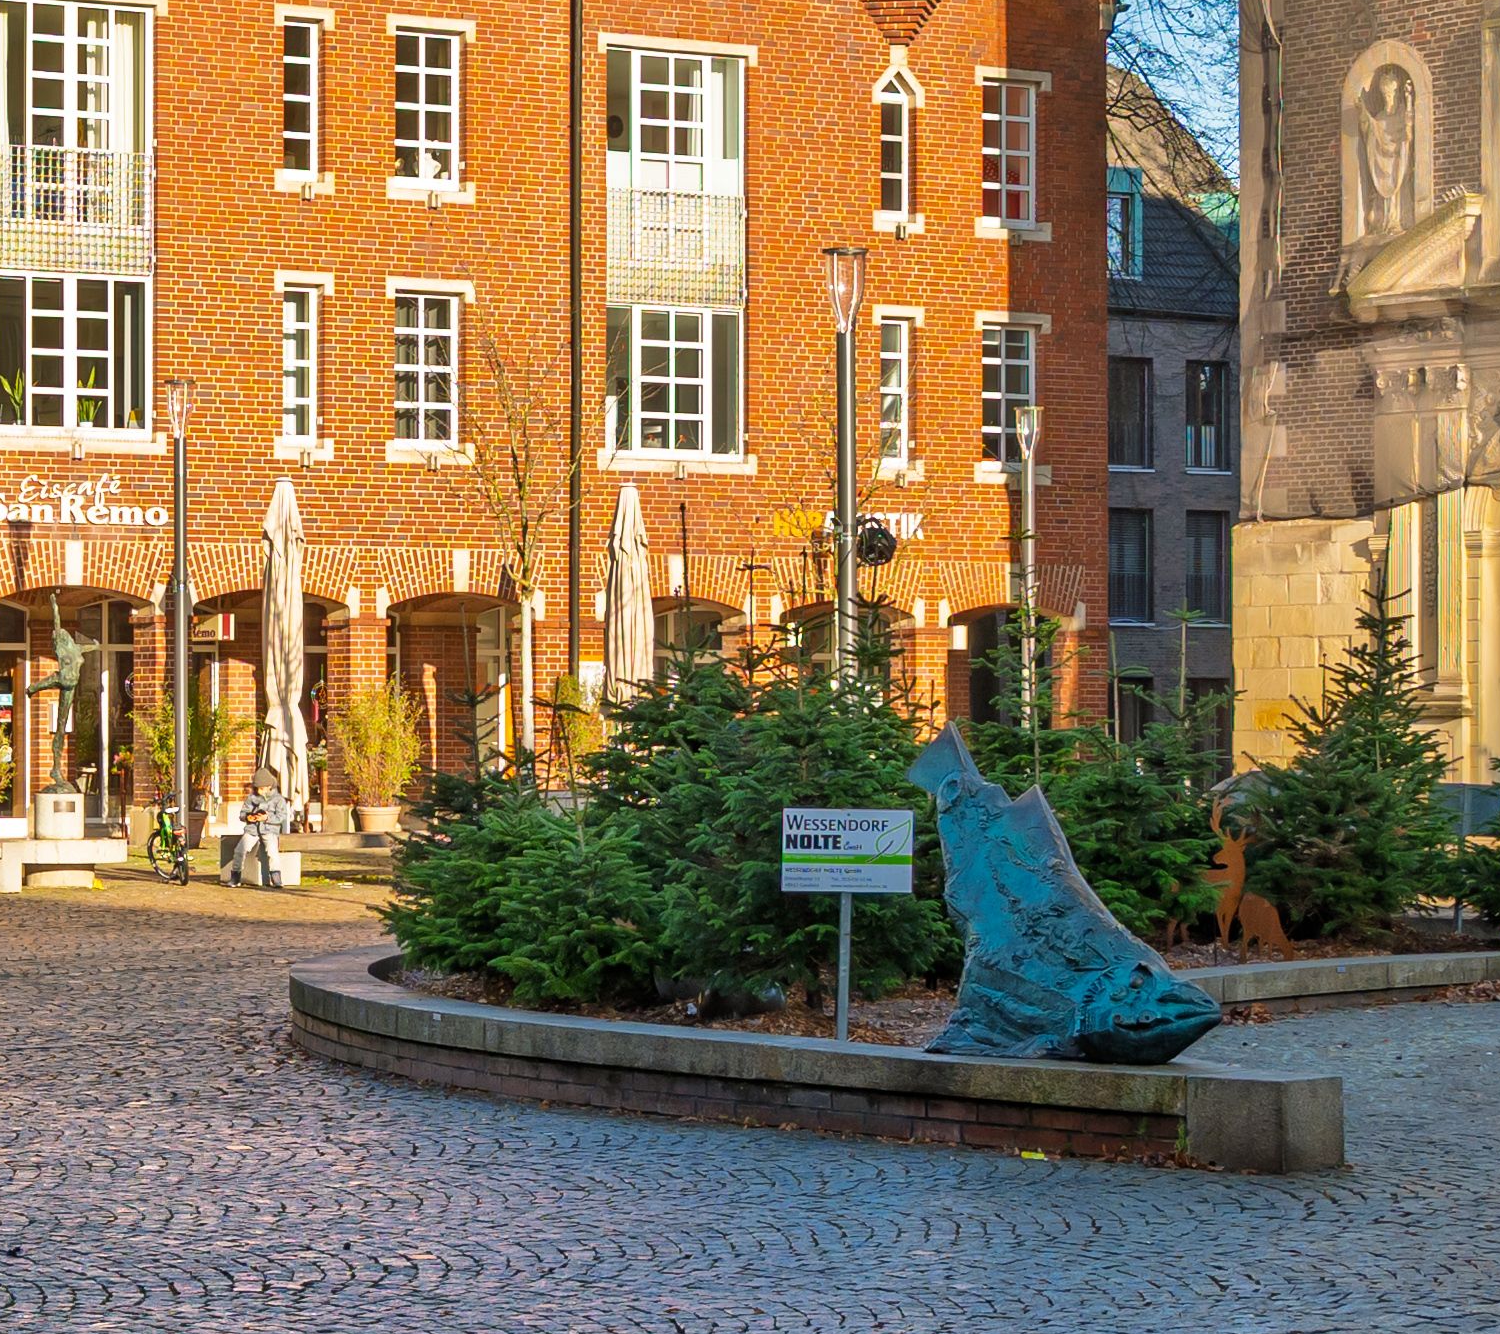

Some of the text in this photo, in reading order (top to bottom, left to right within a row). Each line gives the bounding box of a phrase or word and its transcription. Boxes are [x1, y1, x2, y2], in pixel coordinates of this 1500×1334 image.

[18, 473, 122, 509] Eiscafé
[60, 495, 170, 526] Remo
[786, 814, 889, 832] WESSENDORF
[785, 834, 842, 850] NOLTE
